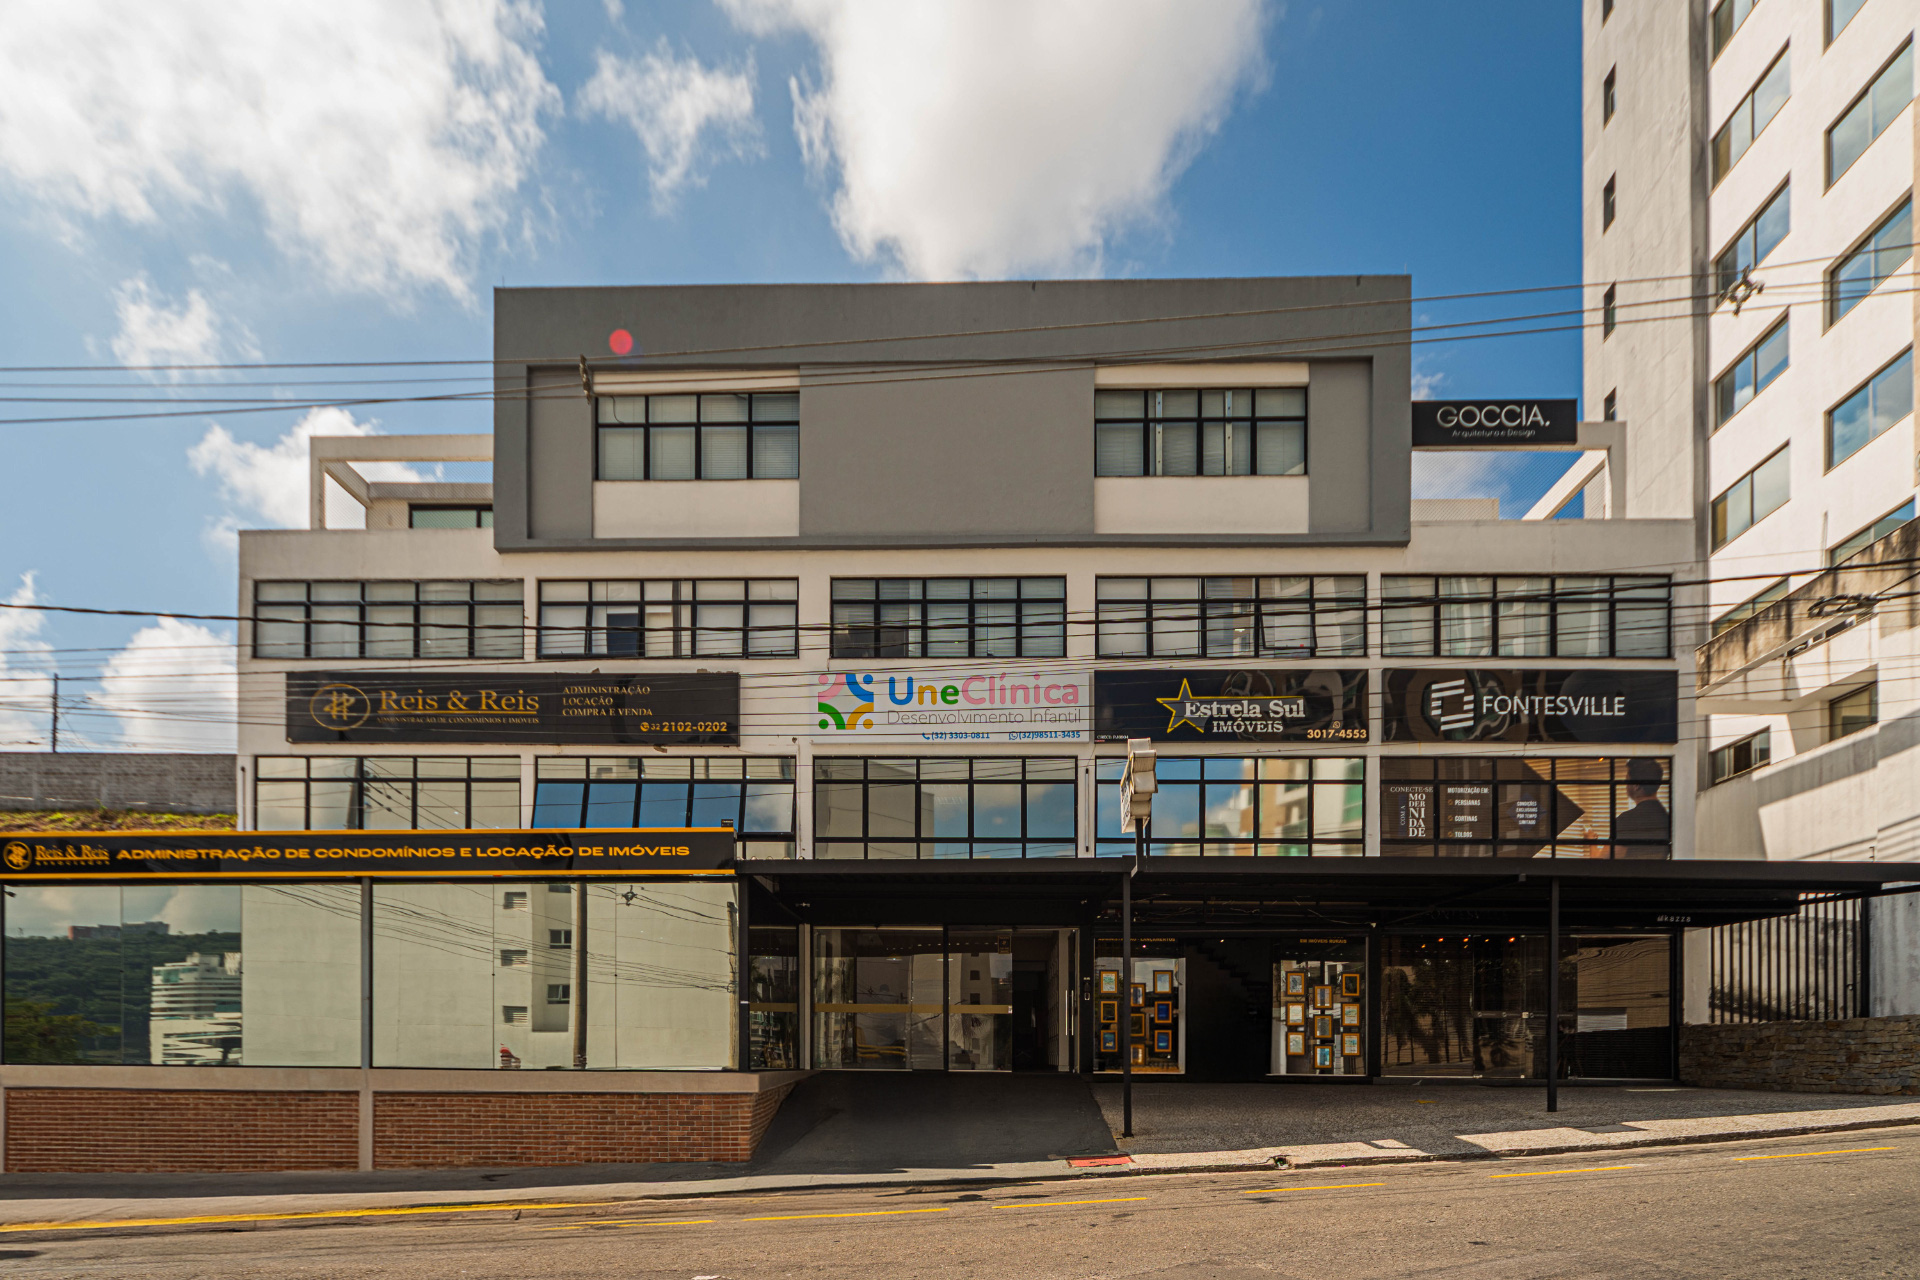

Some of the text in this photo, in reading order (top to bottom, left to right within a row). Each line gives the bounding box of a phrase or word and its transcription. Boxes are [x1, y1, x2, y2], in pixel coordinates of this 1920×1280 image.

[1437, 404, 1550, 428] GOCCIA.
[1507, 429, 1536, 438] Design
[563, 686, 650, 696] ADMINISTRAÇÃO
[888, 672, 1079, 705] UneClínica
[379, 689, 540, 711] Reis & Reis
[562, 696, 614, 707] LOCAÇÃO
[1482, 695, 1626, 716] FONTESVILLE
[562, 708, 653, 716] COMPRA E VENDA
[1184, 698, 1305, 718] Estrela Sul
[448, 715, 502, 724] CONDOMÍNIOS
[508, 715, 539, 724] IMÓVEIS
[887, 708, 1081, 725] Desenvolvimento Infantil
[651, 722, 728, 732] 32 2102-0202
[1212, 718, 1283, 733] IMÓVEIS
[931, 731, 990, 741] (32) 3303-0811
[1307, 729, 1367, 739] 3017-4553
[1447, 786, 1480, 795] MOTORIZAÇÃO
[35, 844, 110, 858] Reis & Reis
[116, 843, 690, 861] ADMINISTRAÇÃO DE CONDOMÍNIOS E LOCAÇÃO DE IMÓVEIS
